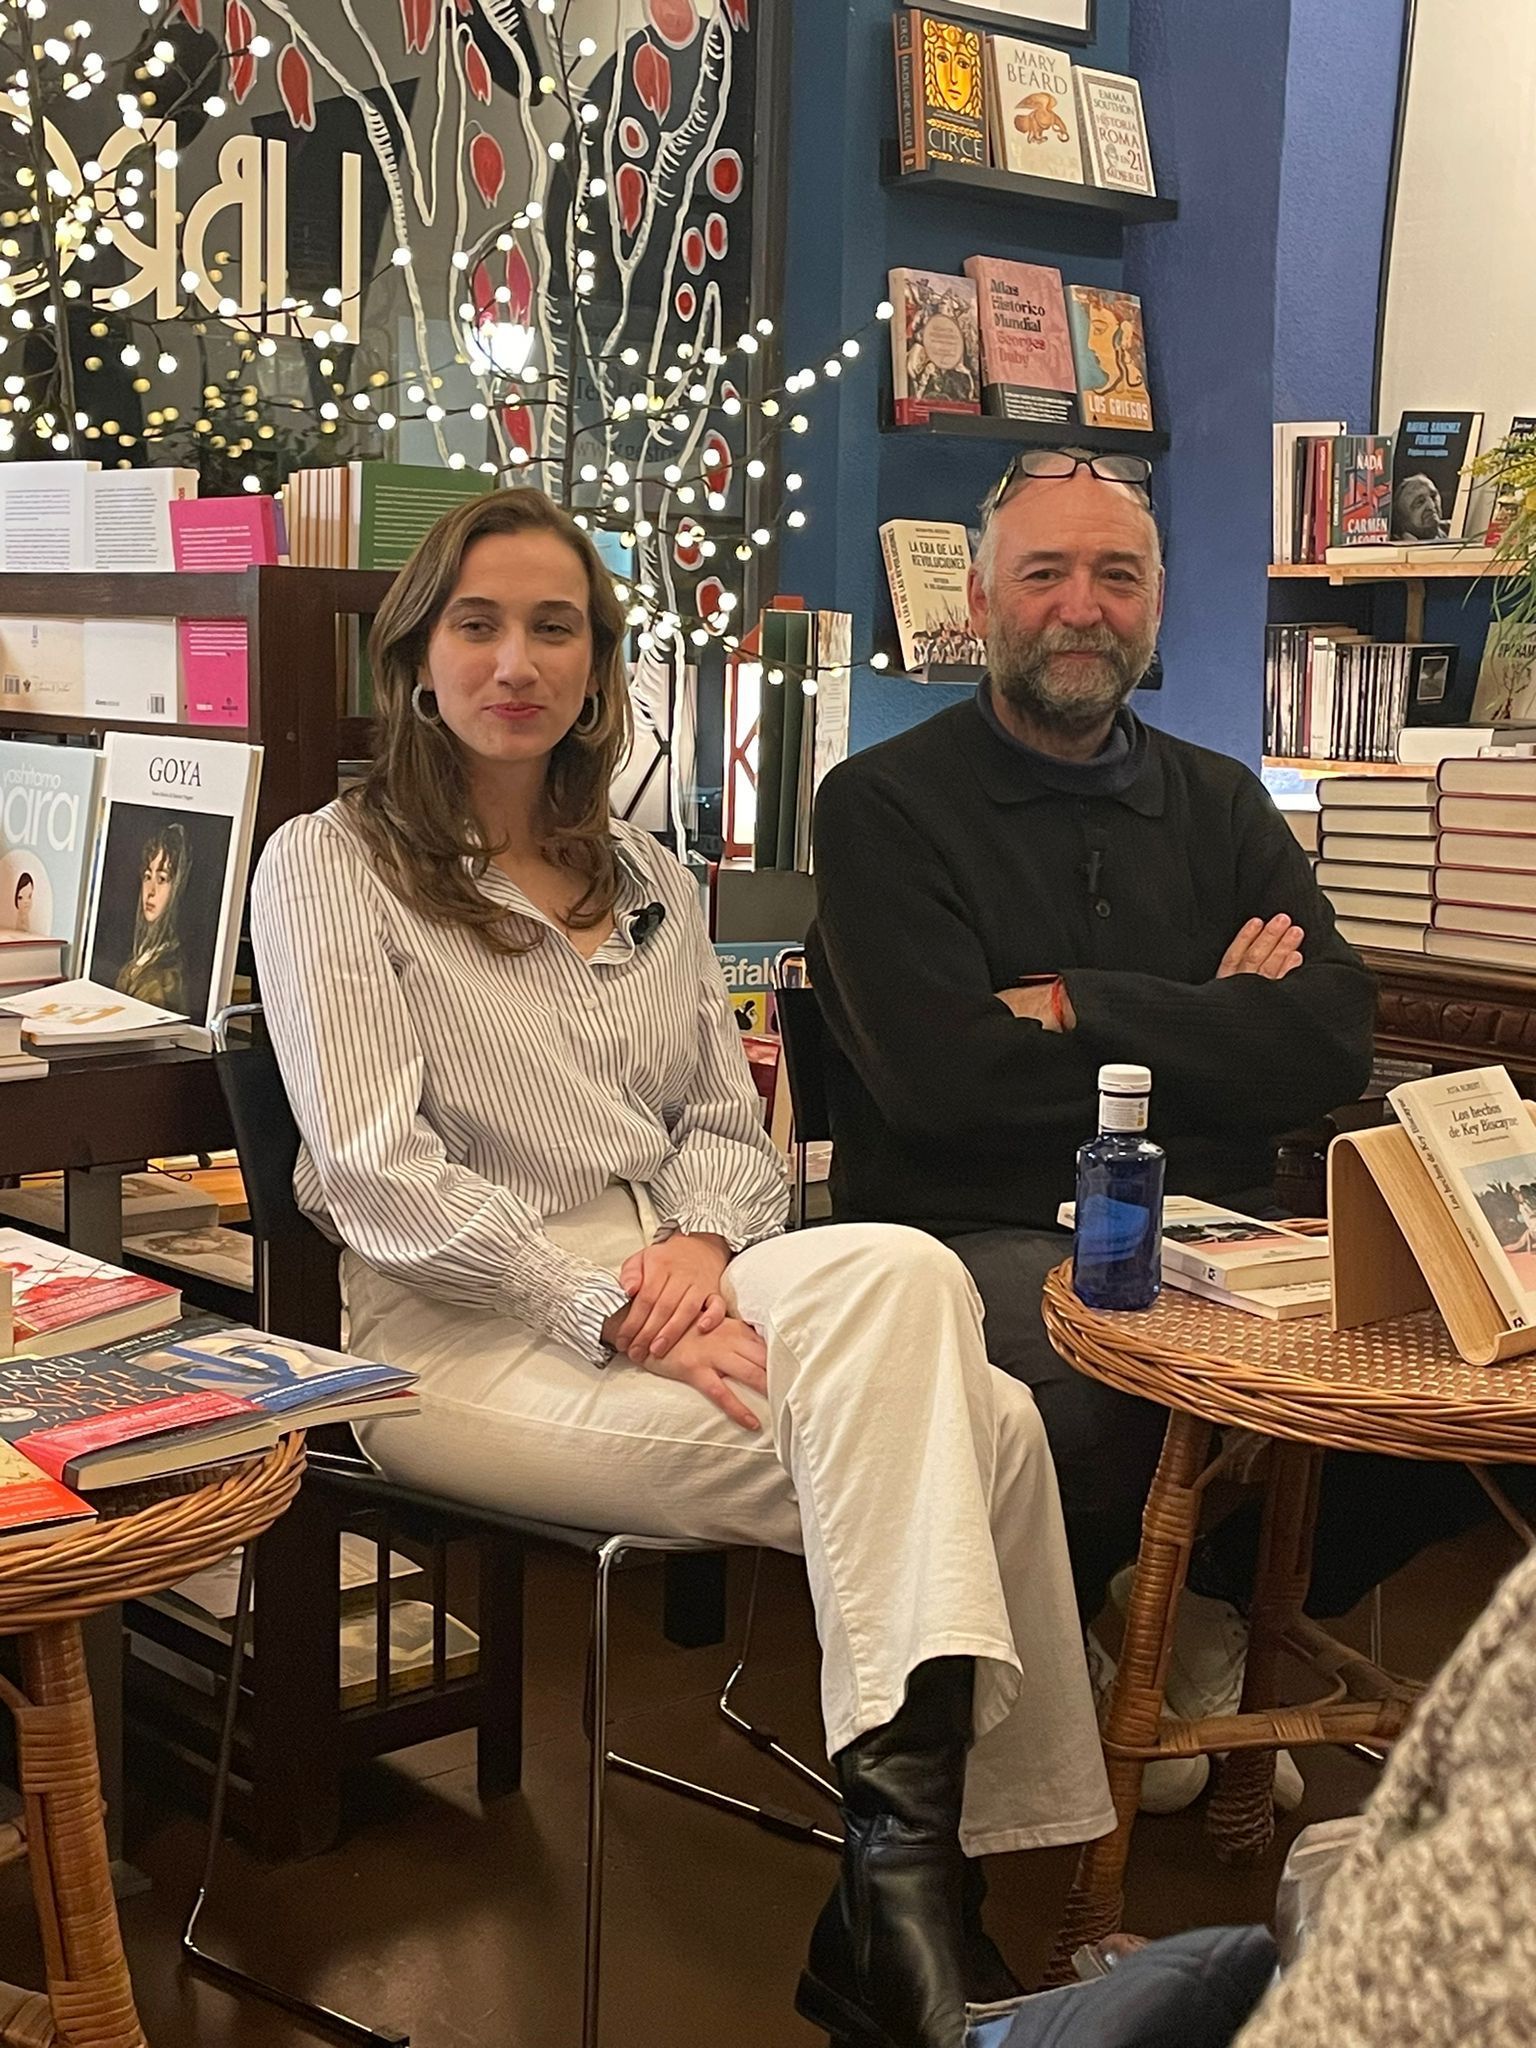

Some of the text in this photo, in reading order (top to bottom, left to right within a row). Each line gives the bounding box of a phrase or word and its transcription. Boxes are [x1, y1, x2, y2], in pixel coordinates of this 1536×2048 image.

[900, 17, 909, 49] CIRCE
[1015, 49, 1056, 73] MARY
[1007, 63, 1068, 95] BEARD
[902, 55, 913, 148] MADELINE MILLER
[1098, 88, 1127, 104] EMMA
[1093, 99, 1134, 116] SOUTHON
[1096, 114, 1138, 132] HISTORIA
[928, 127, 983, 161] CIRCE
[1099, 127, 1140, 149] ROMA
[1127, 149, 1143, 172] 21
[991, 279, 1019, 297] Atlas
[994, 313, 1042, 332] Mundial
[996, 331, 1046, 351] Georges
[998, 349, 1030, 368] Duby
[1087, 394, 1107, 414] LOS
[1109, 397, 1149, 421] GRIEGOS
[1356, 450, 1384, 471] NADA
[1347, 517, 1389, 534] CARMEN
[908, 541, 964, 556] LA ERA DE LAS
[911, 554, 966, 570] REVOLUCIONES
[3, 763, 62, 789] yoshitomo
[149, 757, 201, 787] GOYA
[722, 957, 774, 986] afal
[1452, 1102, 1502, 1122] Los hechos
[1448, 1117, 1520, 1139] de Key Biscayne
[1, 1357, 97, 1380] RAÚL
[88, 1383, 179, 1413] REY
